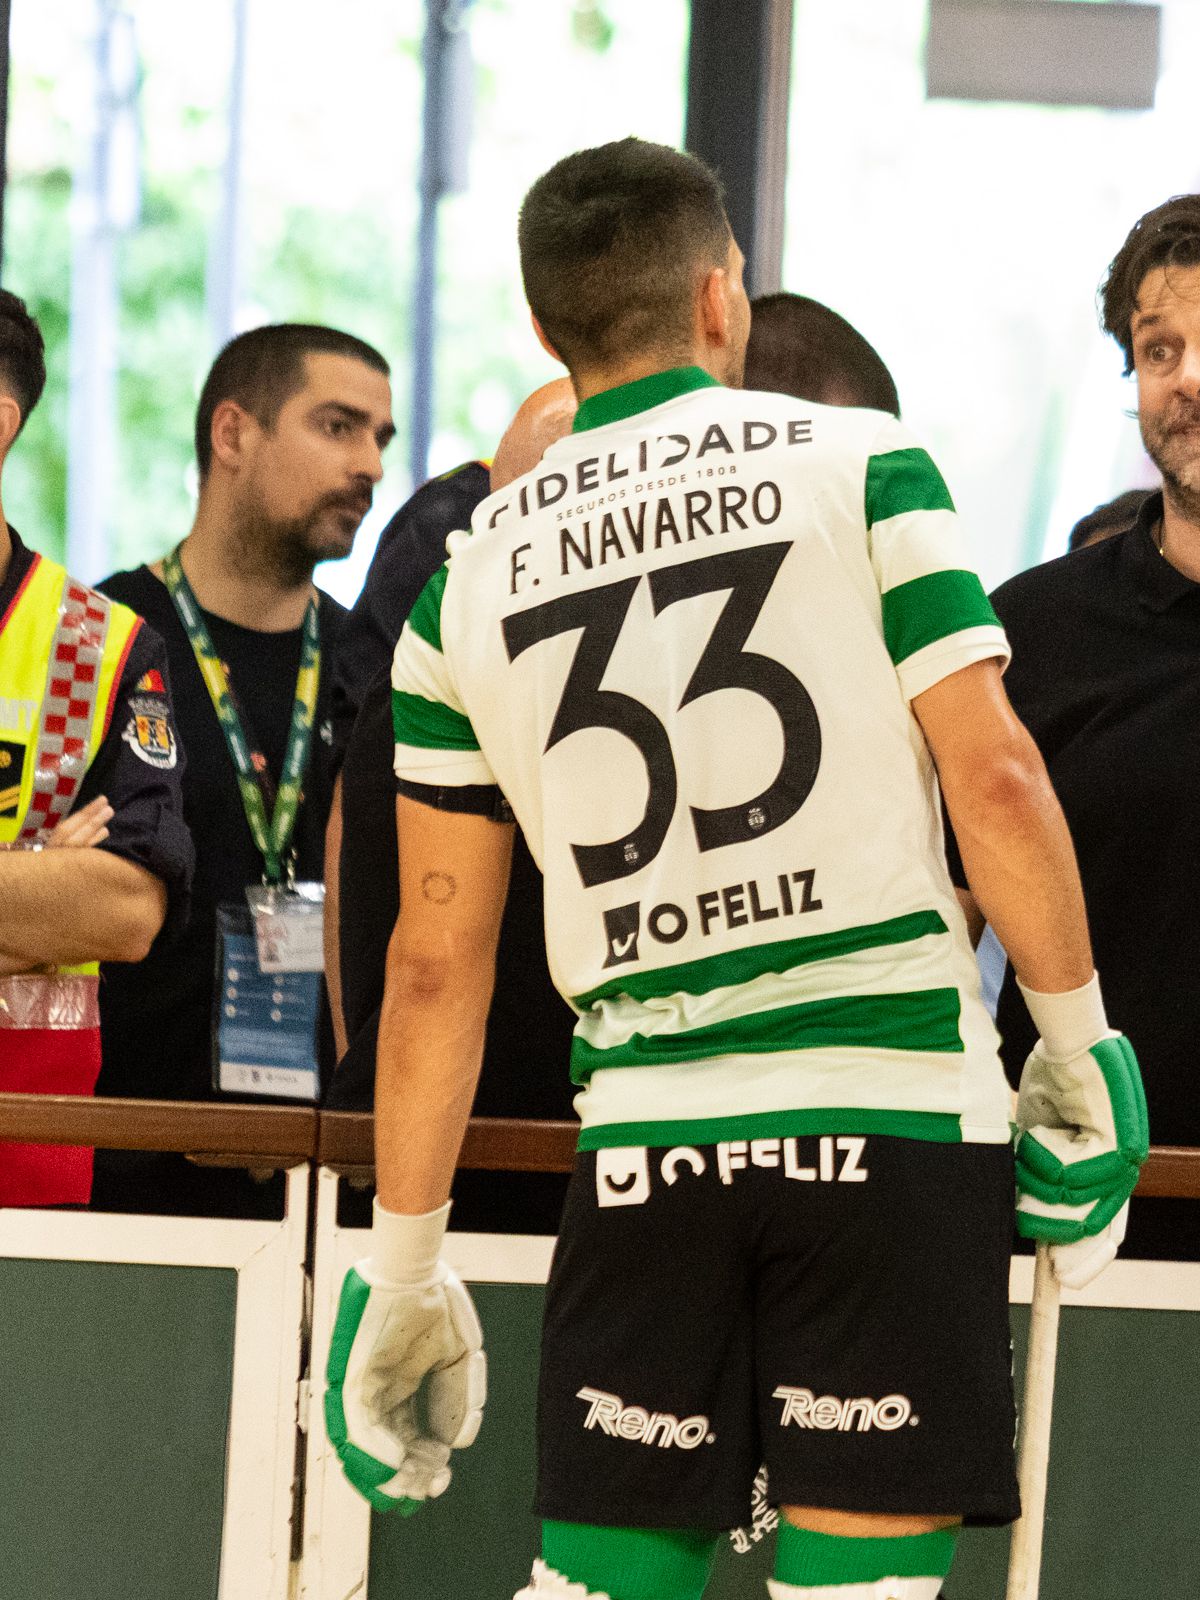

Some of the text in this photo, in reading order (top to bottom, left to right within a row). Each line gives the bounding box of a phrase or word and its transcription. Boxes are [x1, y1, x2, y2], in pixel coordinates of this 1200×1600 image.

[556, 465, 737, 522] SEGUROS DESDE 1808
[510, 480, 783, 595] F. NAVARRO
[500, 540, 823, 889] 33
[647, 868, 823, 944] O FELIZ
[717, 1135, 868, 1186] FELIZ
[576, 1386, 710, 1450] Reno
[771, 1384, 912, 1432] Reno
